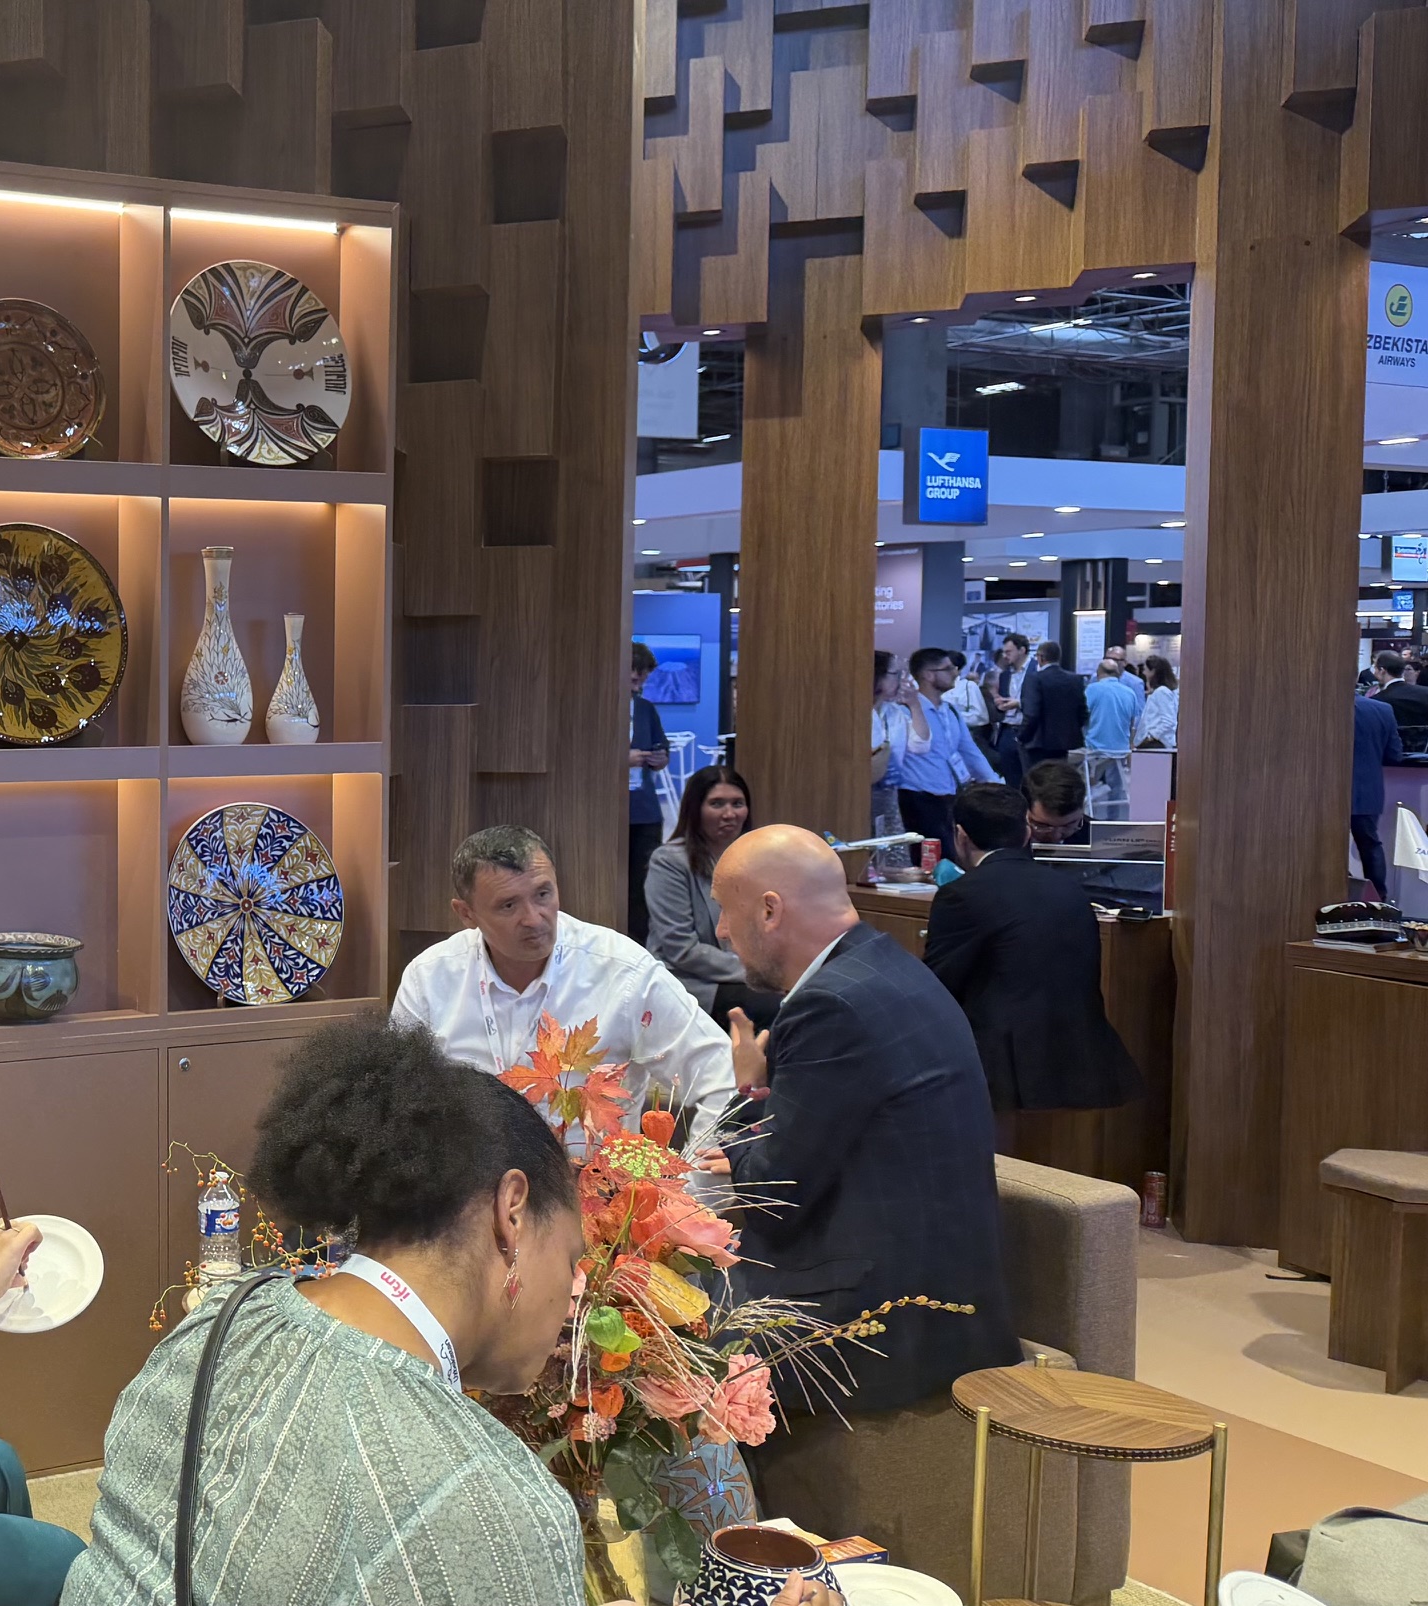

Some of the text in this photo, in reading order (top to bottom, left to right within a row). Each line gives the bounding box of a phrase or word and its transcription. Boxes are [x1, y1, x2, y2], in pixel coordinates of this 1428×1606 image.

[1367, 334, 1428, 355] ZBEKISTA
[1378, 355, 1416, 368] AIRWAYS
[926, 475, 982, 489] LUFTHANSA
[926, 488, 960, 499] GROUP
[1415, 847, 1428, 856] ZA
[380, 1271, 411, 1302] iftm
